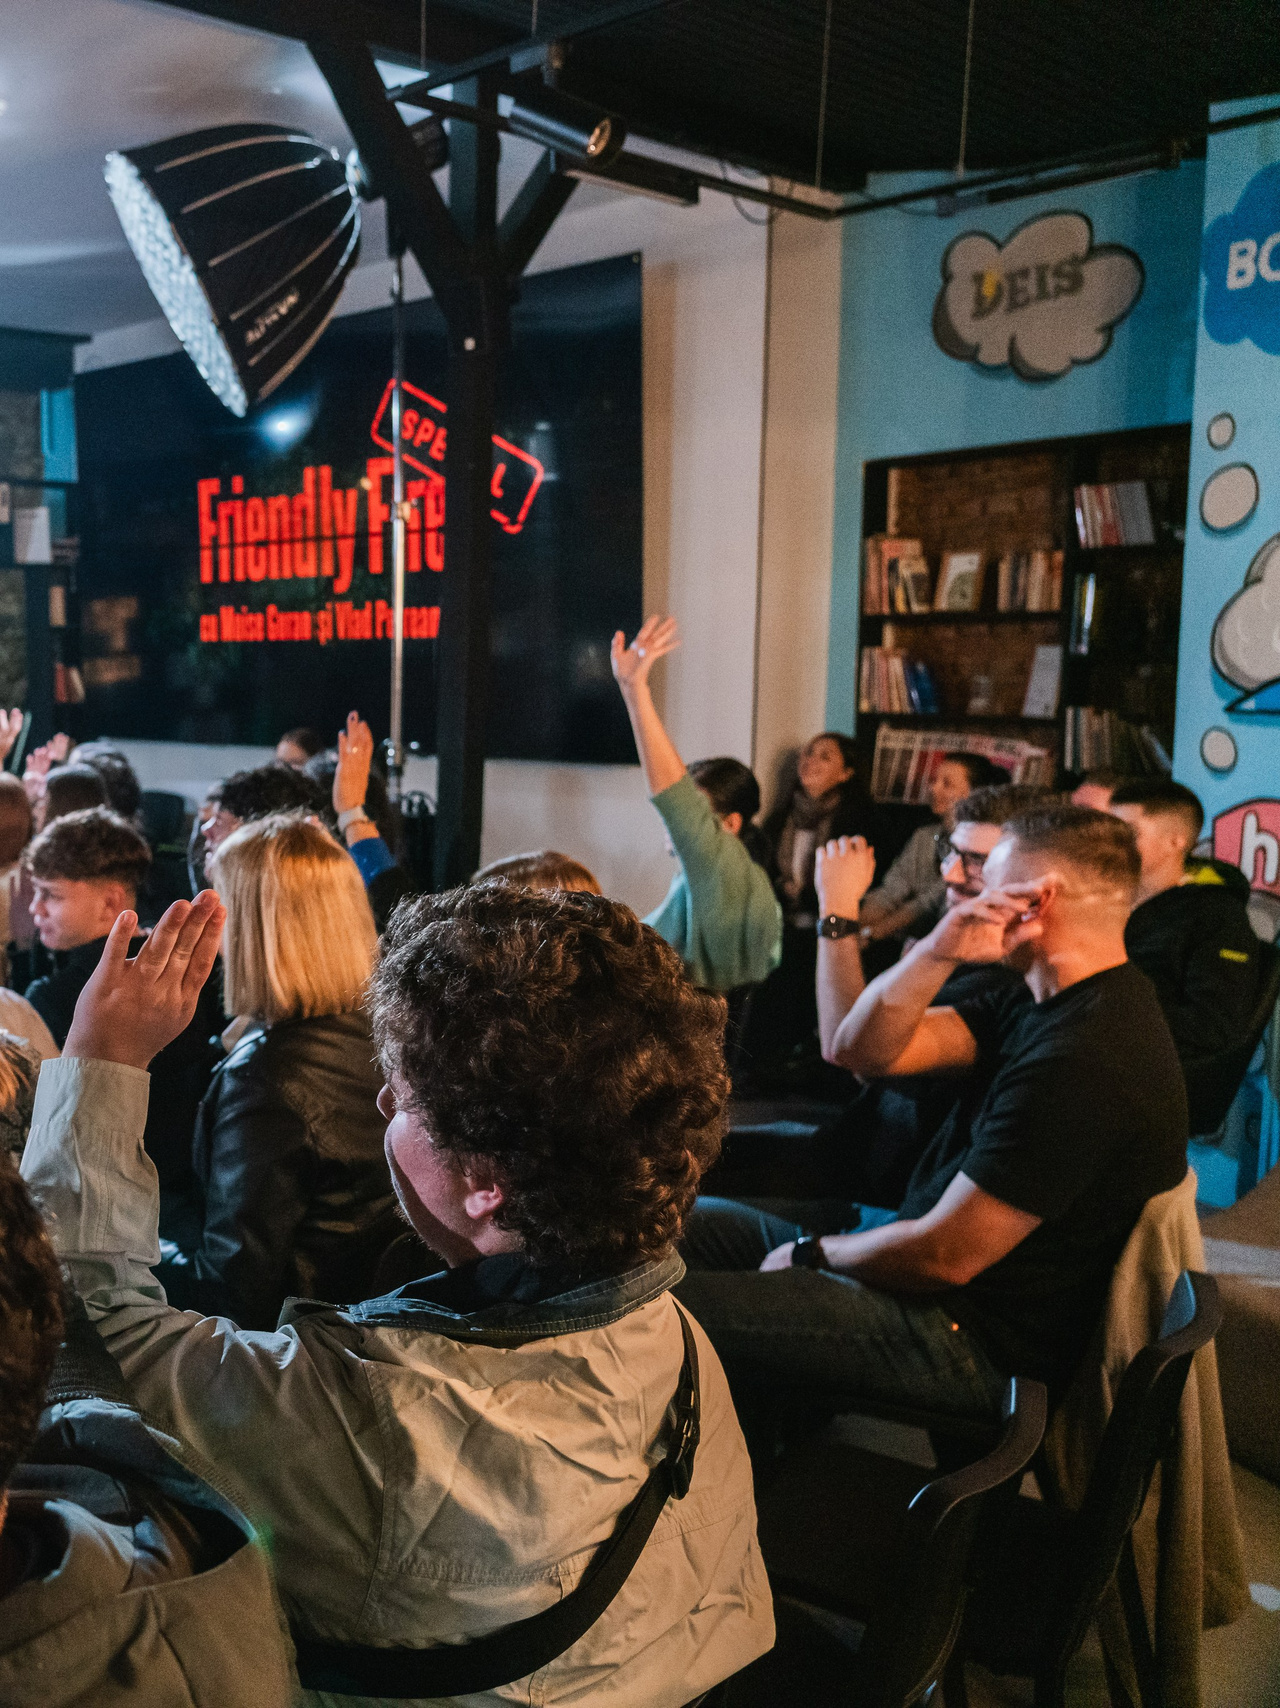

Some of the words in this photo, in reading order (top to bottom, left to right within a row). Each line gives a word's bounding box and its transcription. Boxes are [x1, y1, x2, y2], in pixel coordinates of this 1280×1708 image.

[401, 409, 507, 499] SPEL
[197, 464, 358, 595] Friendly
[366, 457, 446, 574] Fre
